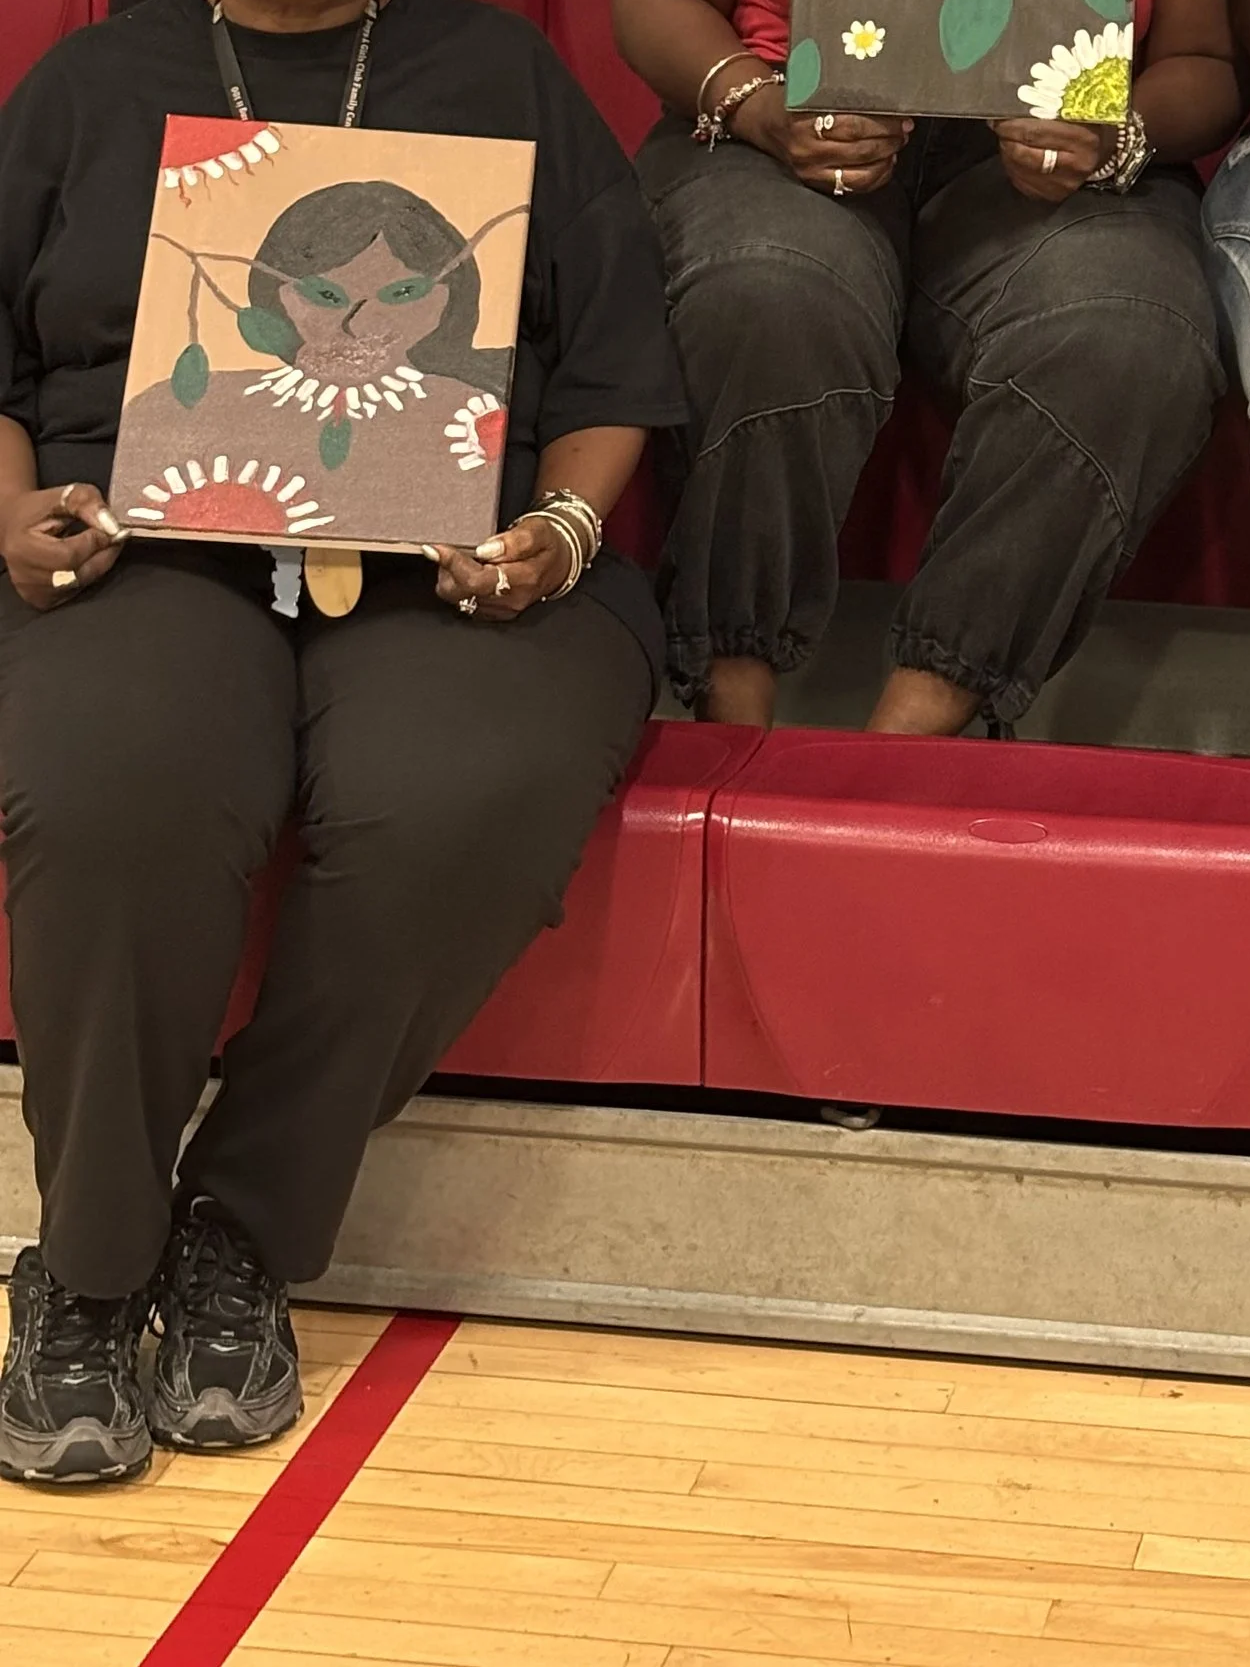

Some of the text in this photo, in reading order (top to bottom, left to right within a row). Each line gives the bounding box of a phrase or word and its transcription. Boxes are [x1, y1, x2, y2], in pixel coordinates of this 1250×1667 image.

[354, 63, 366, 82] Club
[347, 82, 361, 111] Family
[344, 112, 355, 127] Cen
